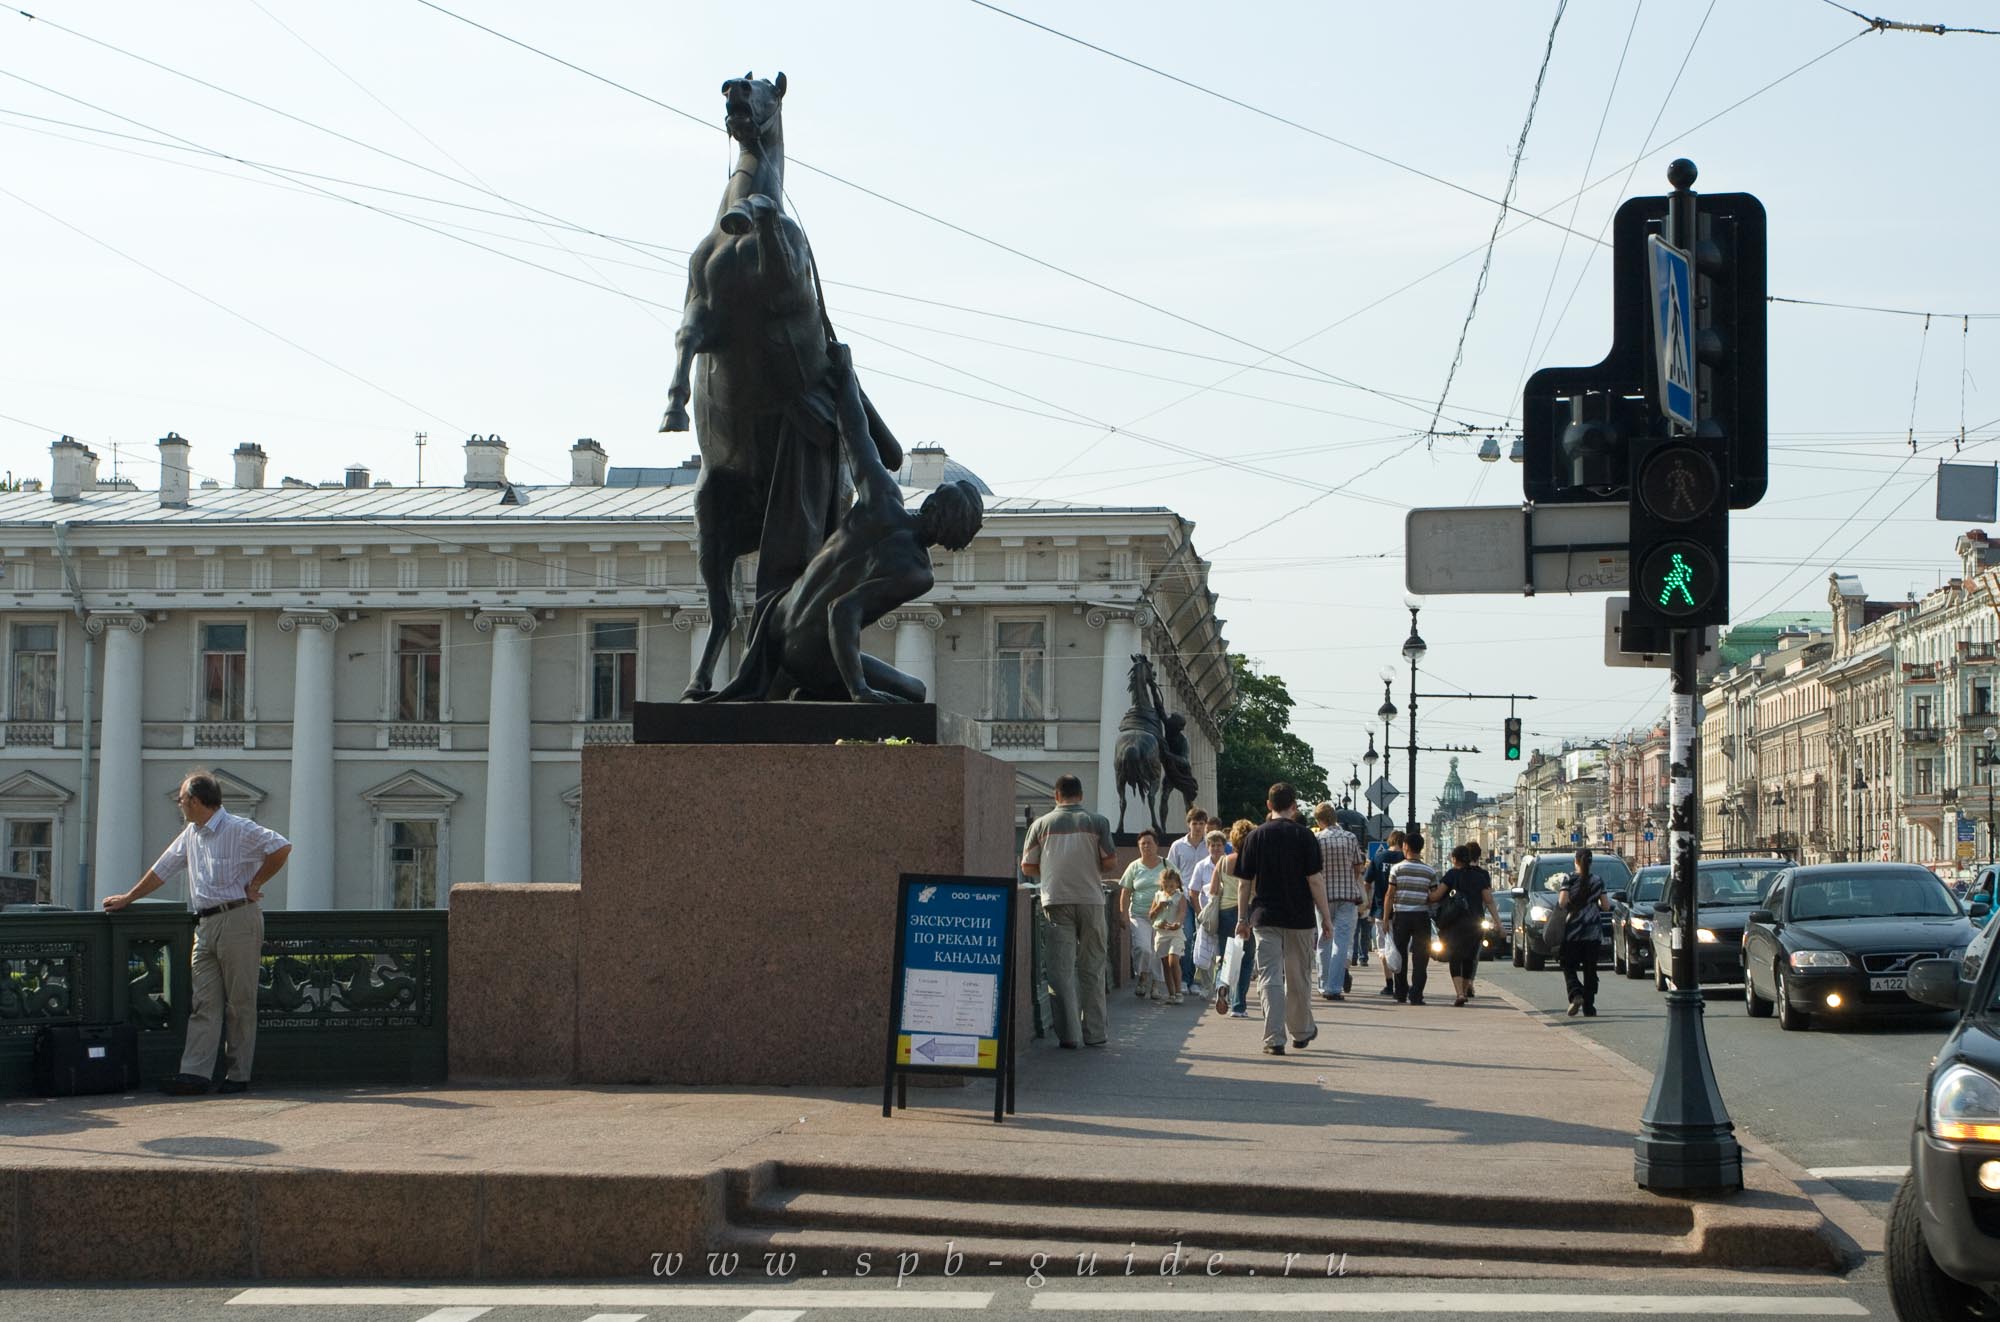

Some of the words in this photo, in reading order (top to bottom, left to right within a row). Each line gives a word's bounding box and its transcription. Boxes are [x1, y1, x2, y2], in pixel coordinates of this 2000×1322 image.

[951, 892, 970, 900] ООО
[910, 915, 991, 928] ЭКСКУРСИИ
[914, 932, 934, 944] ПО
[937, 933, 983, 946] РЕКАМ
[987, 935, 997, 947] И
[934, 951, 1001, 965] КАНАЛАМ
